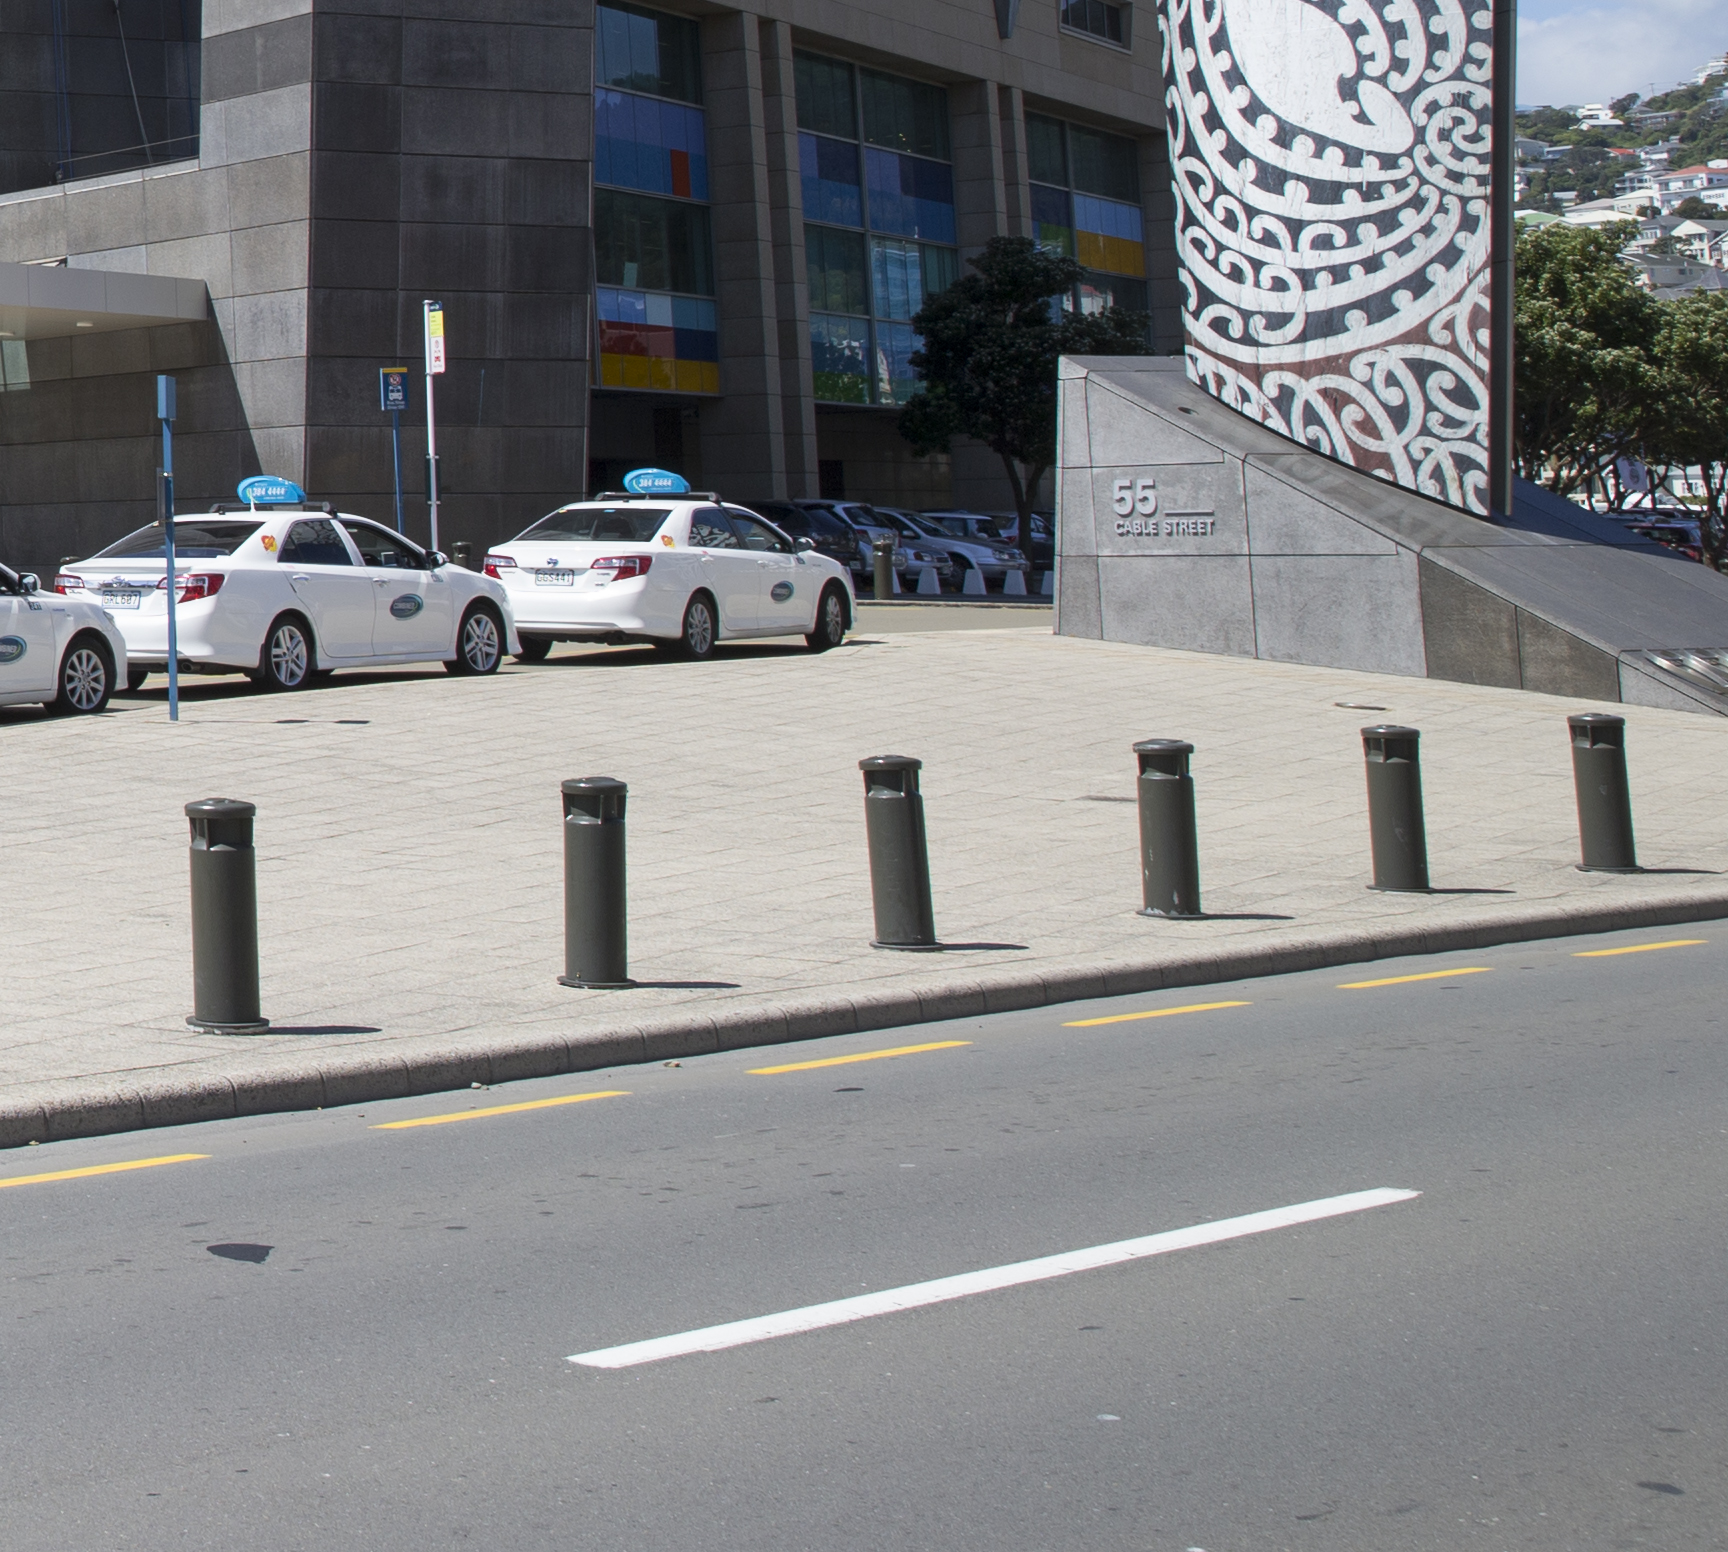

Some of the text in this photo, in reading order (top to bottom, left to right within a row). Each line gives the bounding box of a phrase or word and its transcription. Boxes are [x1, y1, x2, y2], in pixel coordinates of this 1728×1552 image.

[1113, 478, 1158, 518] 55
[1114, 519, 1214, 537] CABLE STREET
